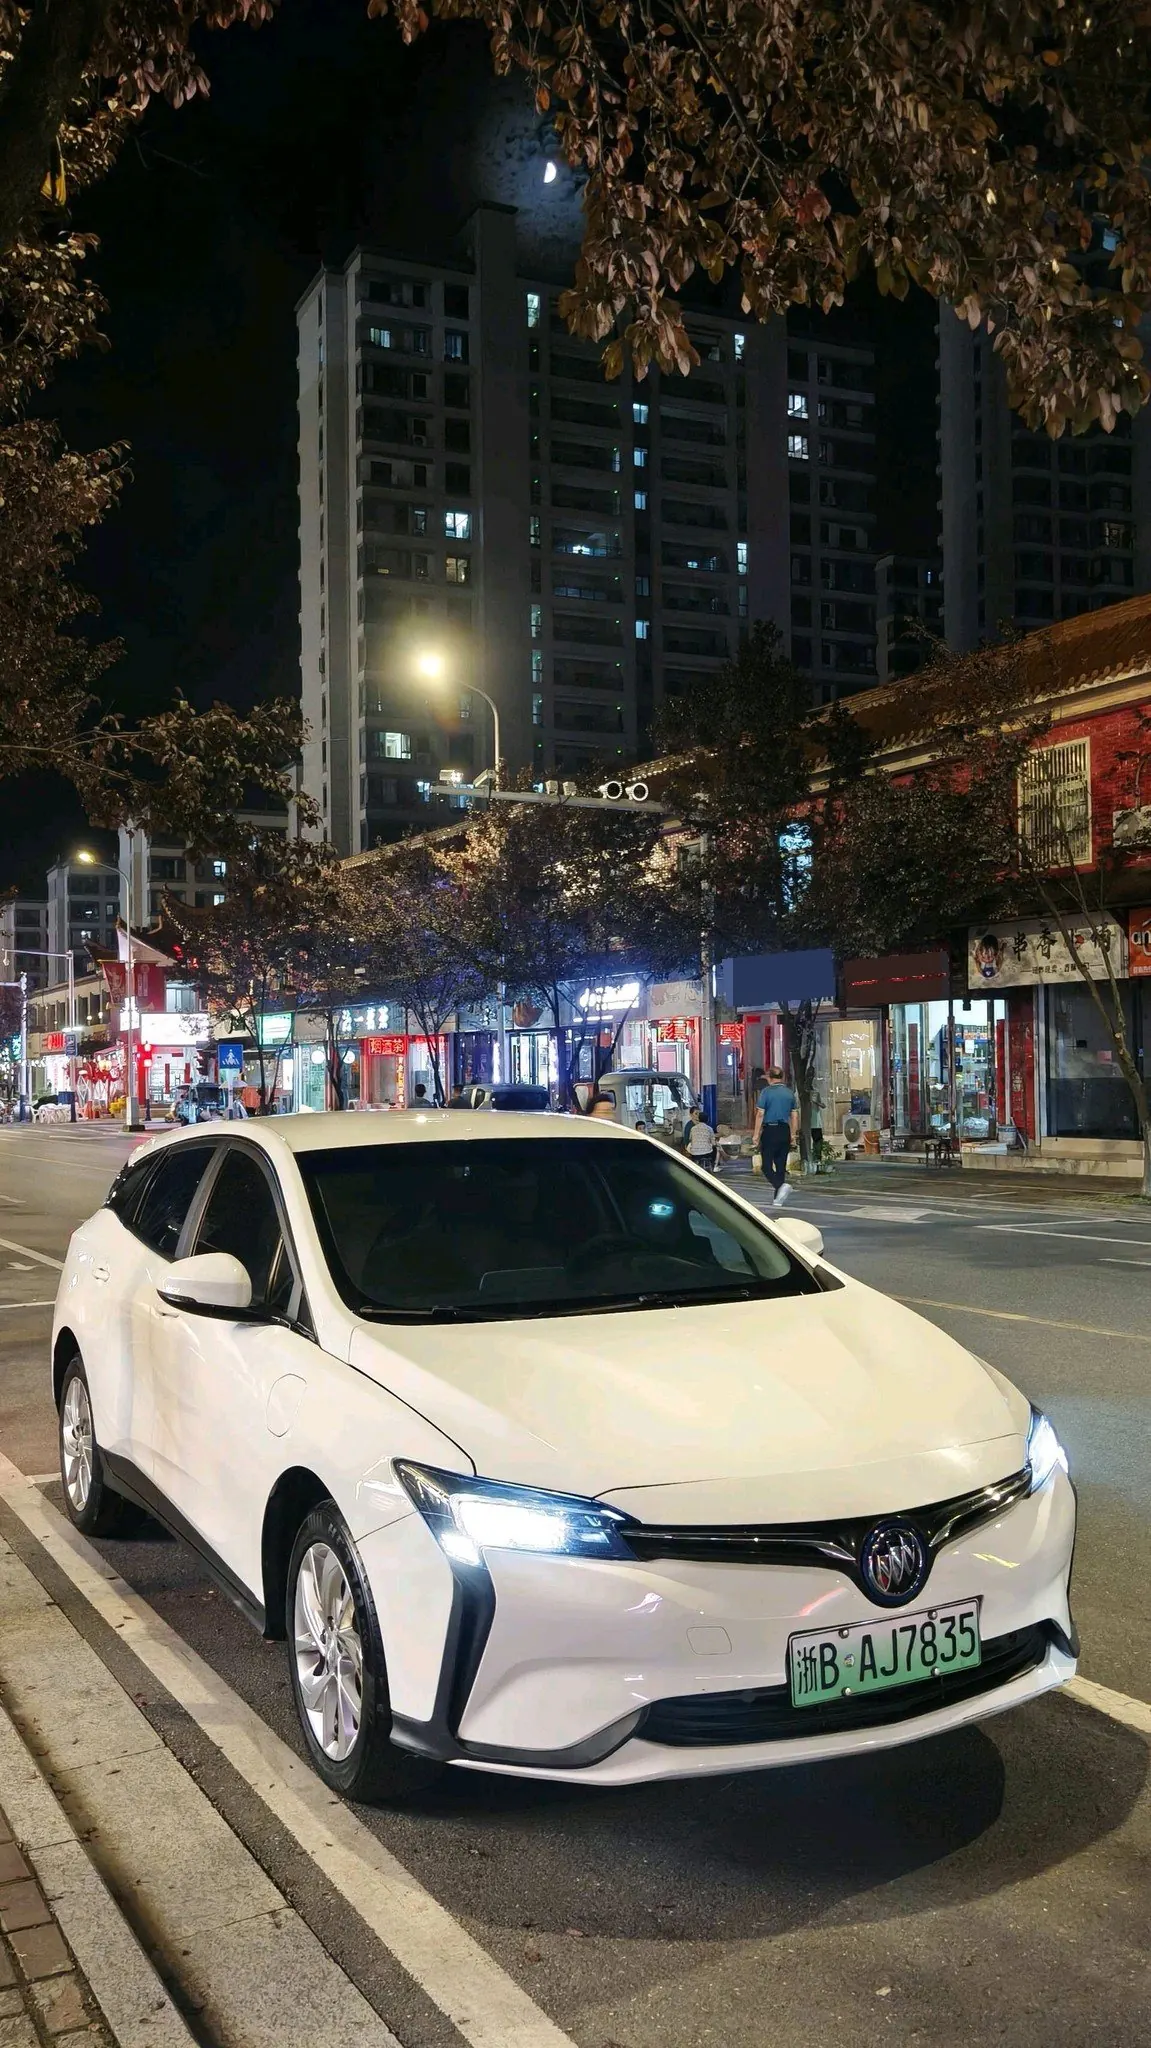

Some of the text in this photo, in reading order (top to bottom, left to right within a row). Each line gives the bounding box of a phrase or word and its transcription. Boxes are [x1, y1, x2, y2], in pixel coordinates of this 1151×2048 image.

[658, 1021, 679, 1035] 彩票
[370, 1038, 404, 1055] 烟酒茶
